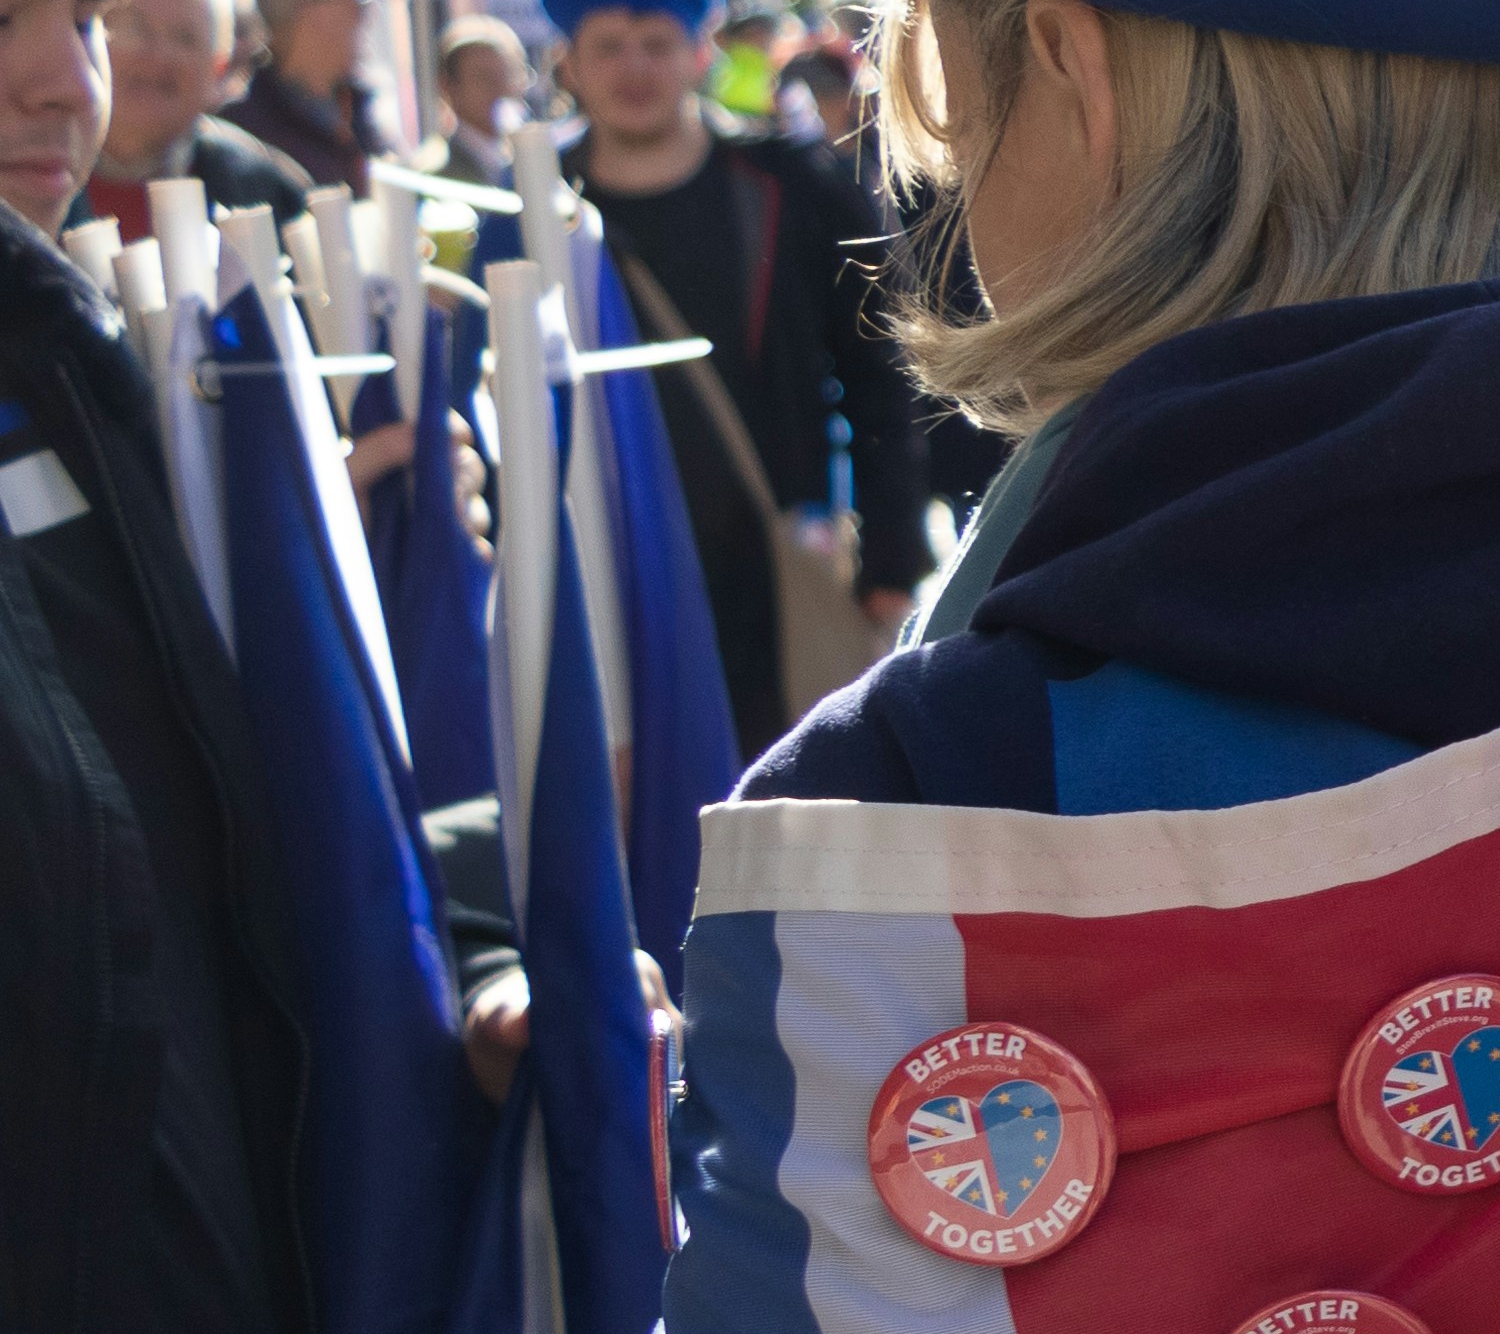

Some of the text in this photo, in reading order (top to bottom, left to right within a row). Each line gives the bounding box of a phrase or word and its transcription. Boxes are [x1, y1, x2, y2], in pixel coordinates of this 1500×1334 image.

[1378, 986, 1494, 1045] BETTER
[905, 1032, 1027, 1084] BETTER
[923, 1178, 1095, 1254] TOGETHER
